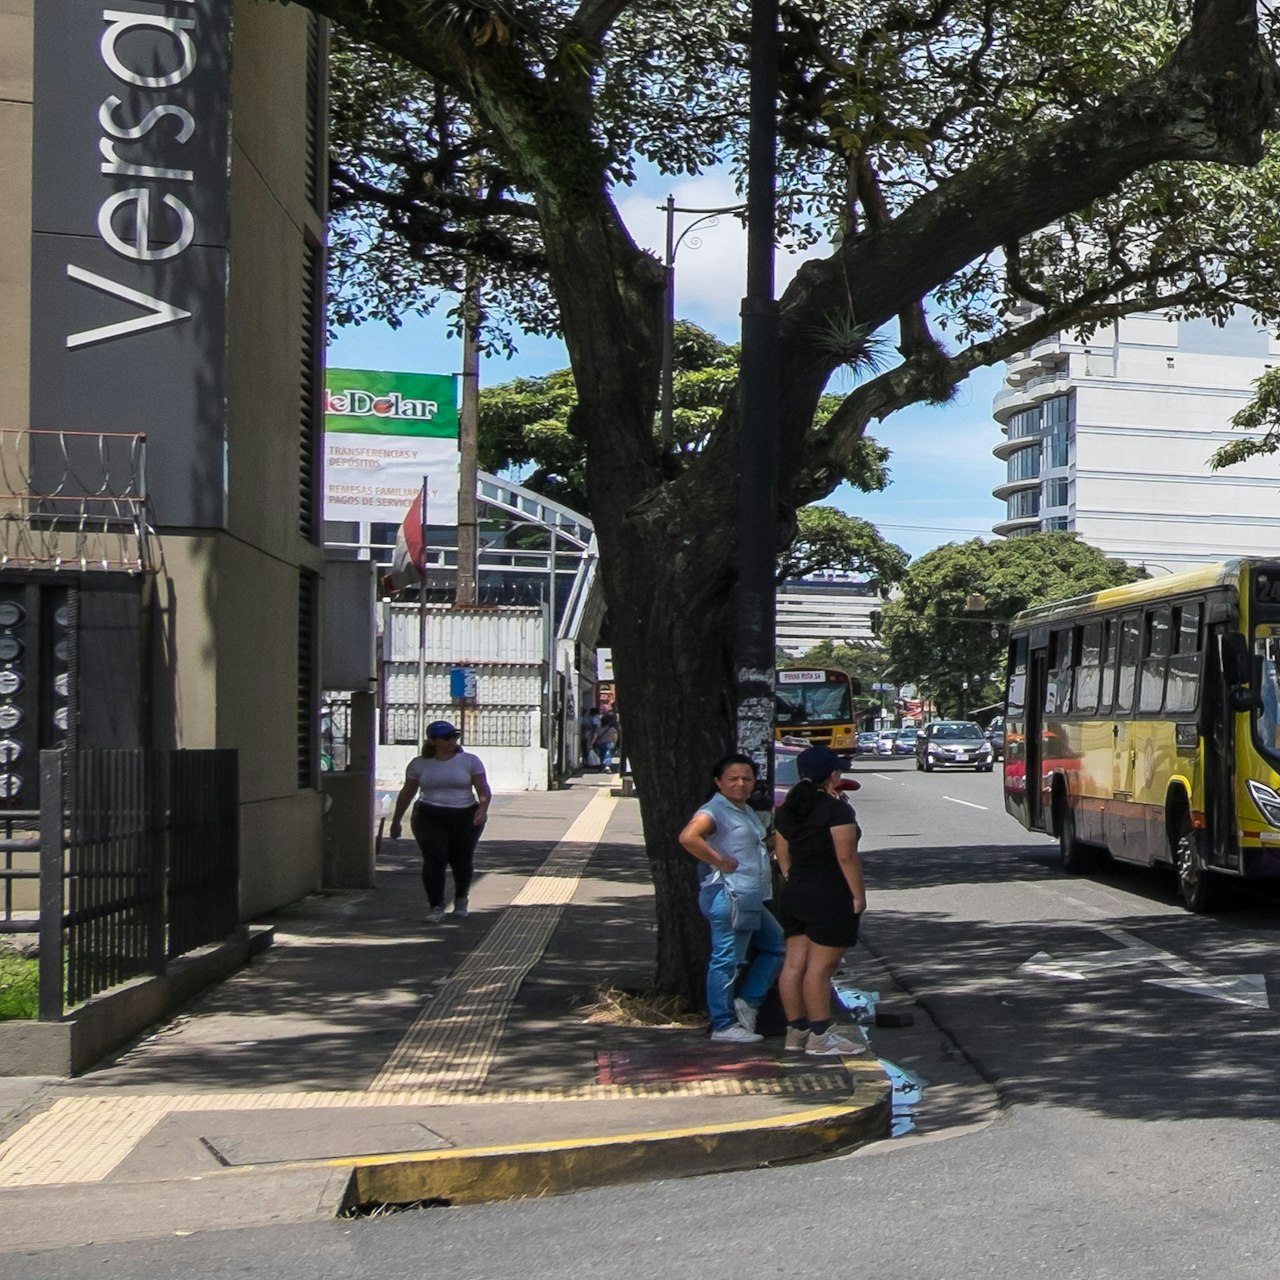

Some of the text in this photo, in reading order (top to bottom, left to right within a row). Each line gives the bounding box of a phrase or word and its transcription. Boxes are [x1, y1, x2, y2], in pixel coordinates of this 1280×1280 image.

[329, 447, 418, 459] TRANSFERENCIAS Y
[329, 485, 372, 495] REMESAS
[329, 496, 360, 505] PAGOS
[362, 497, 374, 505] DE
